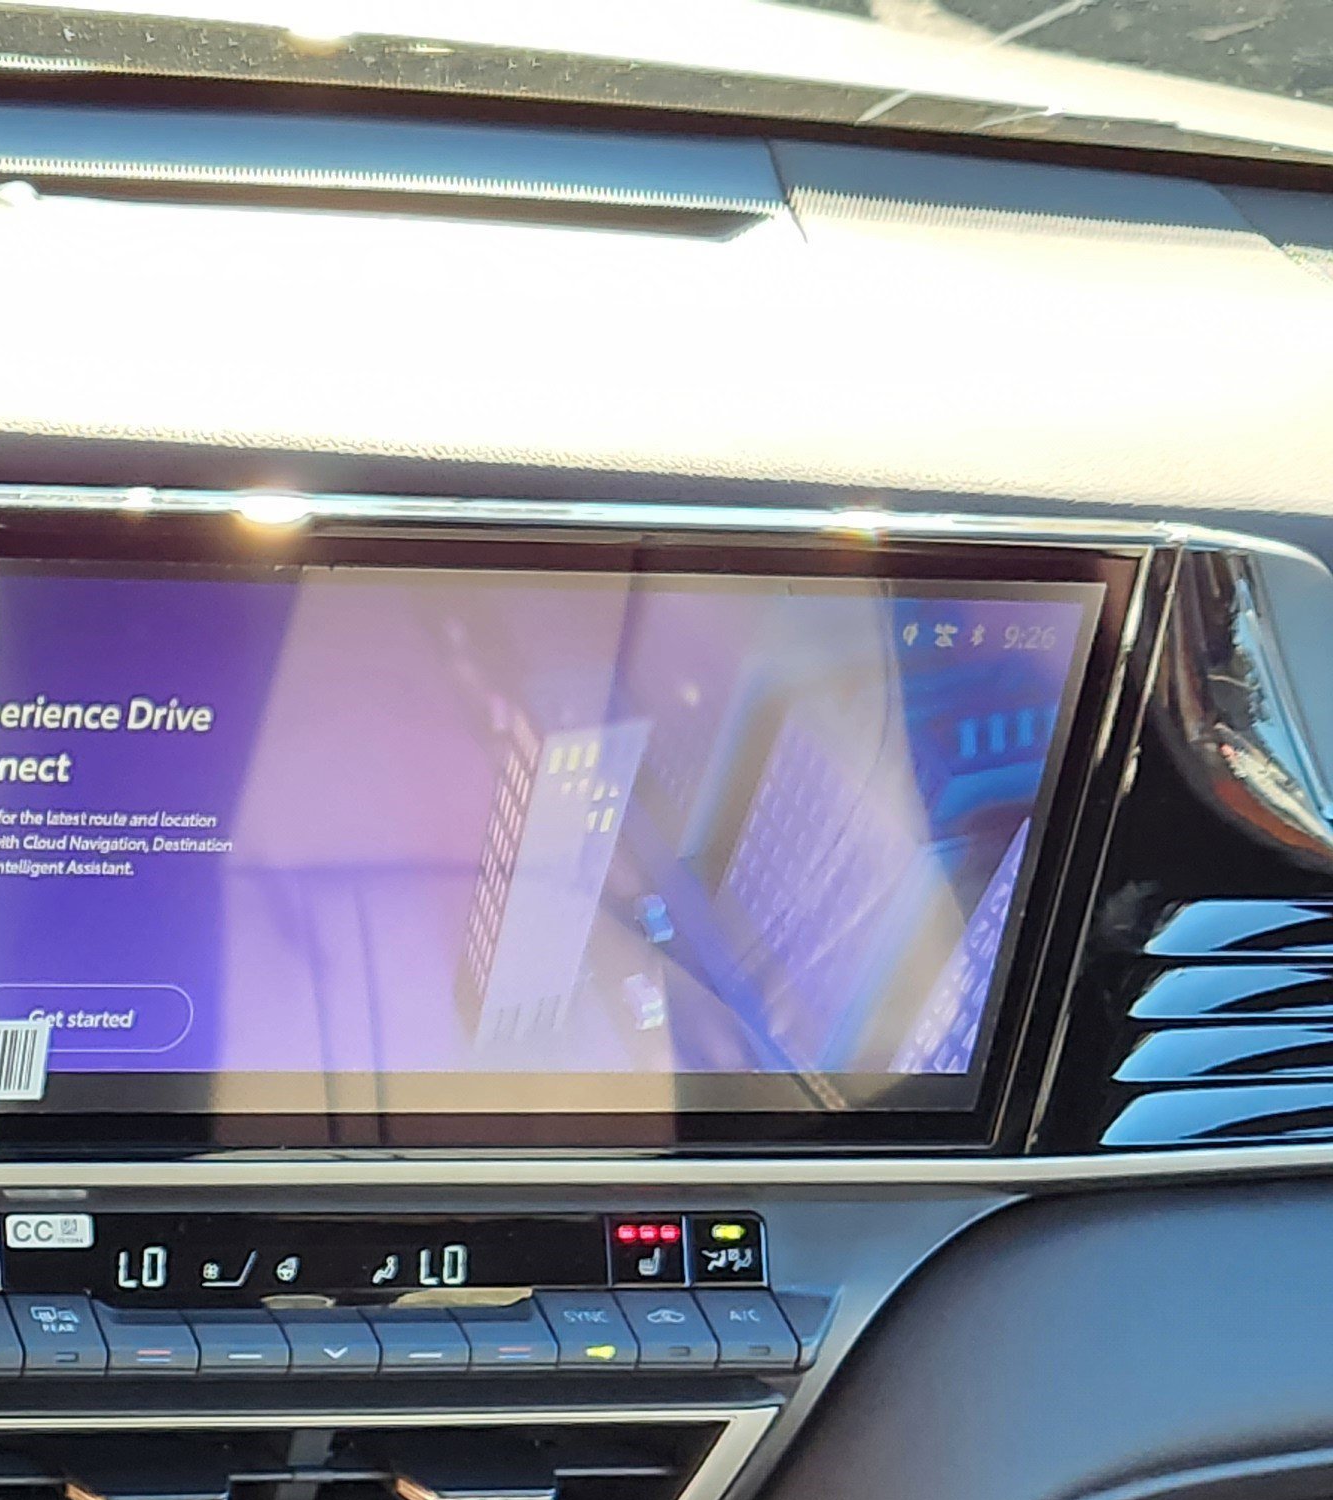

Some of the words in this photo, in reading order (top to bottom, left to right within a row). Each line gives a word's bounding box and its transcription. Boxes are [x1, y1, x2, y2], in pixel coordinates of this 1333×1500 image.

[1004, 626, 1056, 649] 9:26
[127, 698, 212, 732] Drive
[20, 811, 43, 827] the
[46, 811, 87, 827] latest
[89, 813, 126, 828] route
[129, 812, 158, 828] and
[161, 812, 216, 828] location
[23, 836, 66, 851] Cloud
[69, 837, 149, 854] Navigation,
[153, 838, 232, 853] Destination
[66, 861, 134, 877] Assistant.
[66, 1009, 134, 1028] started
[118, 1247, 167, 1288] LO
[419, 1245, 468, 1285] LO
[564, 1310, 608, 1324] SYNC
